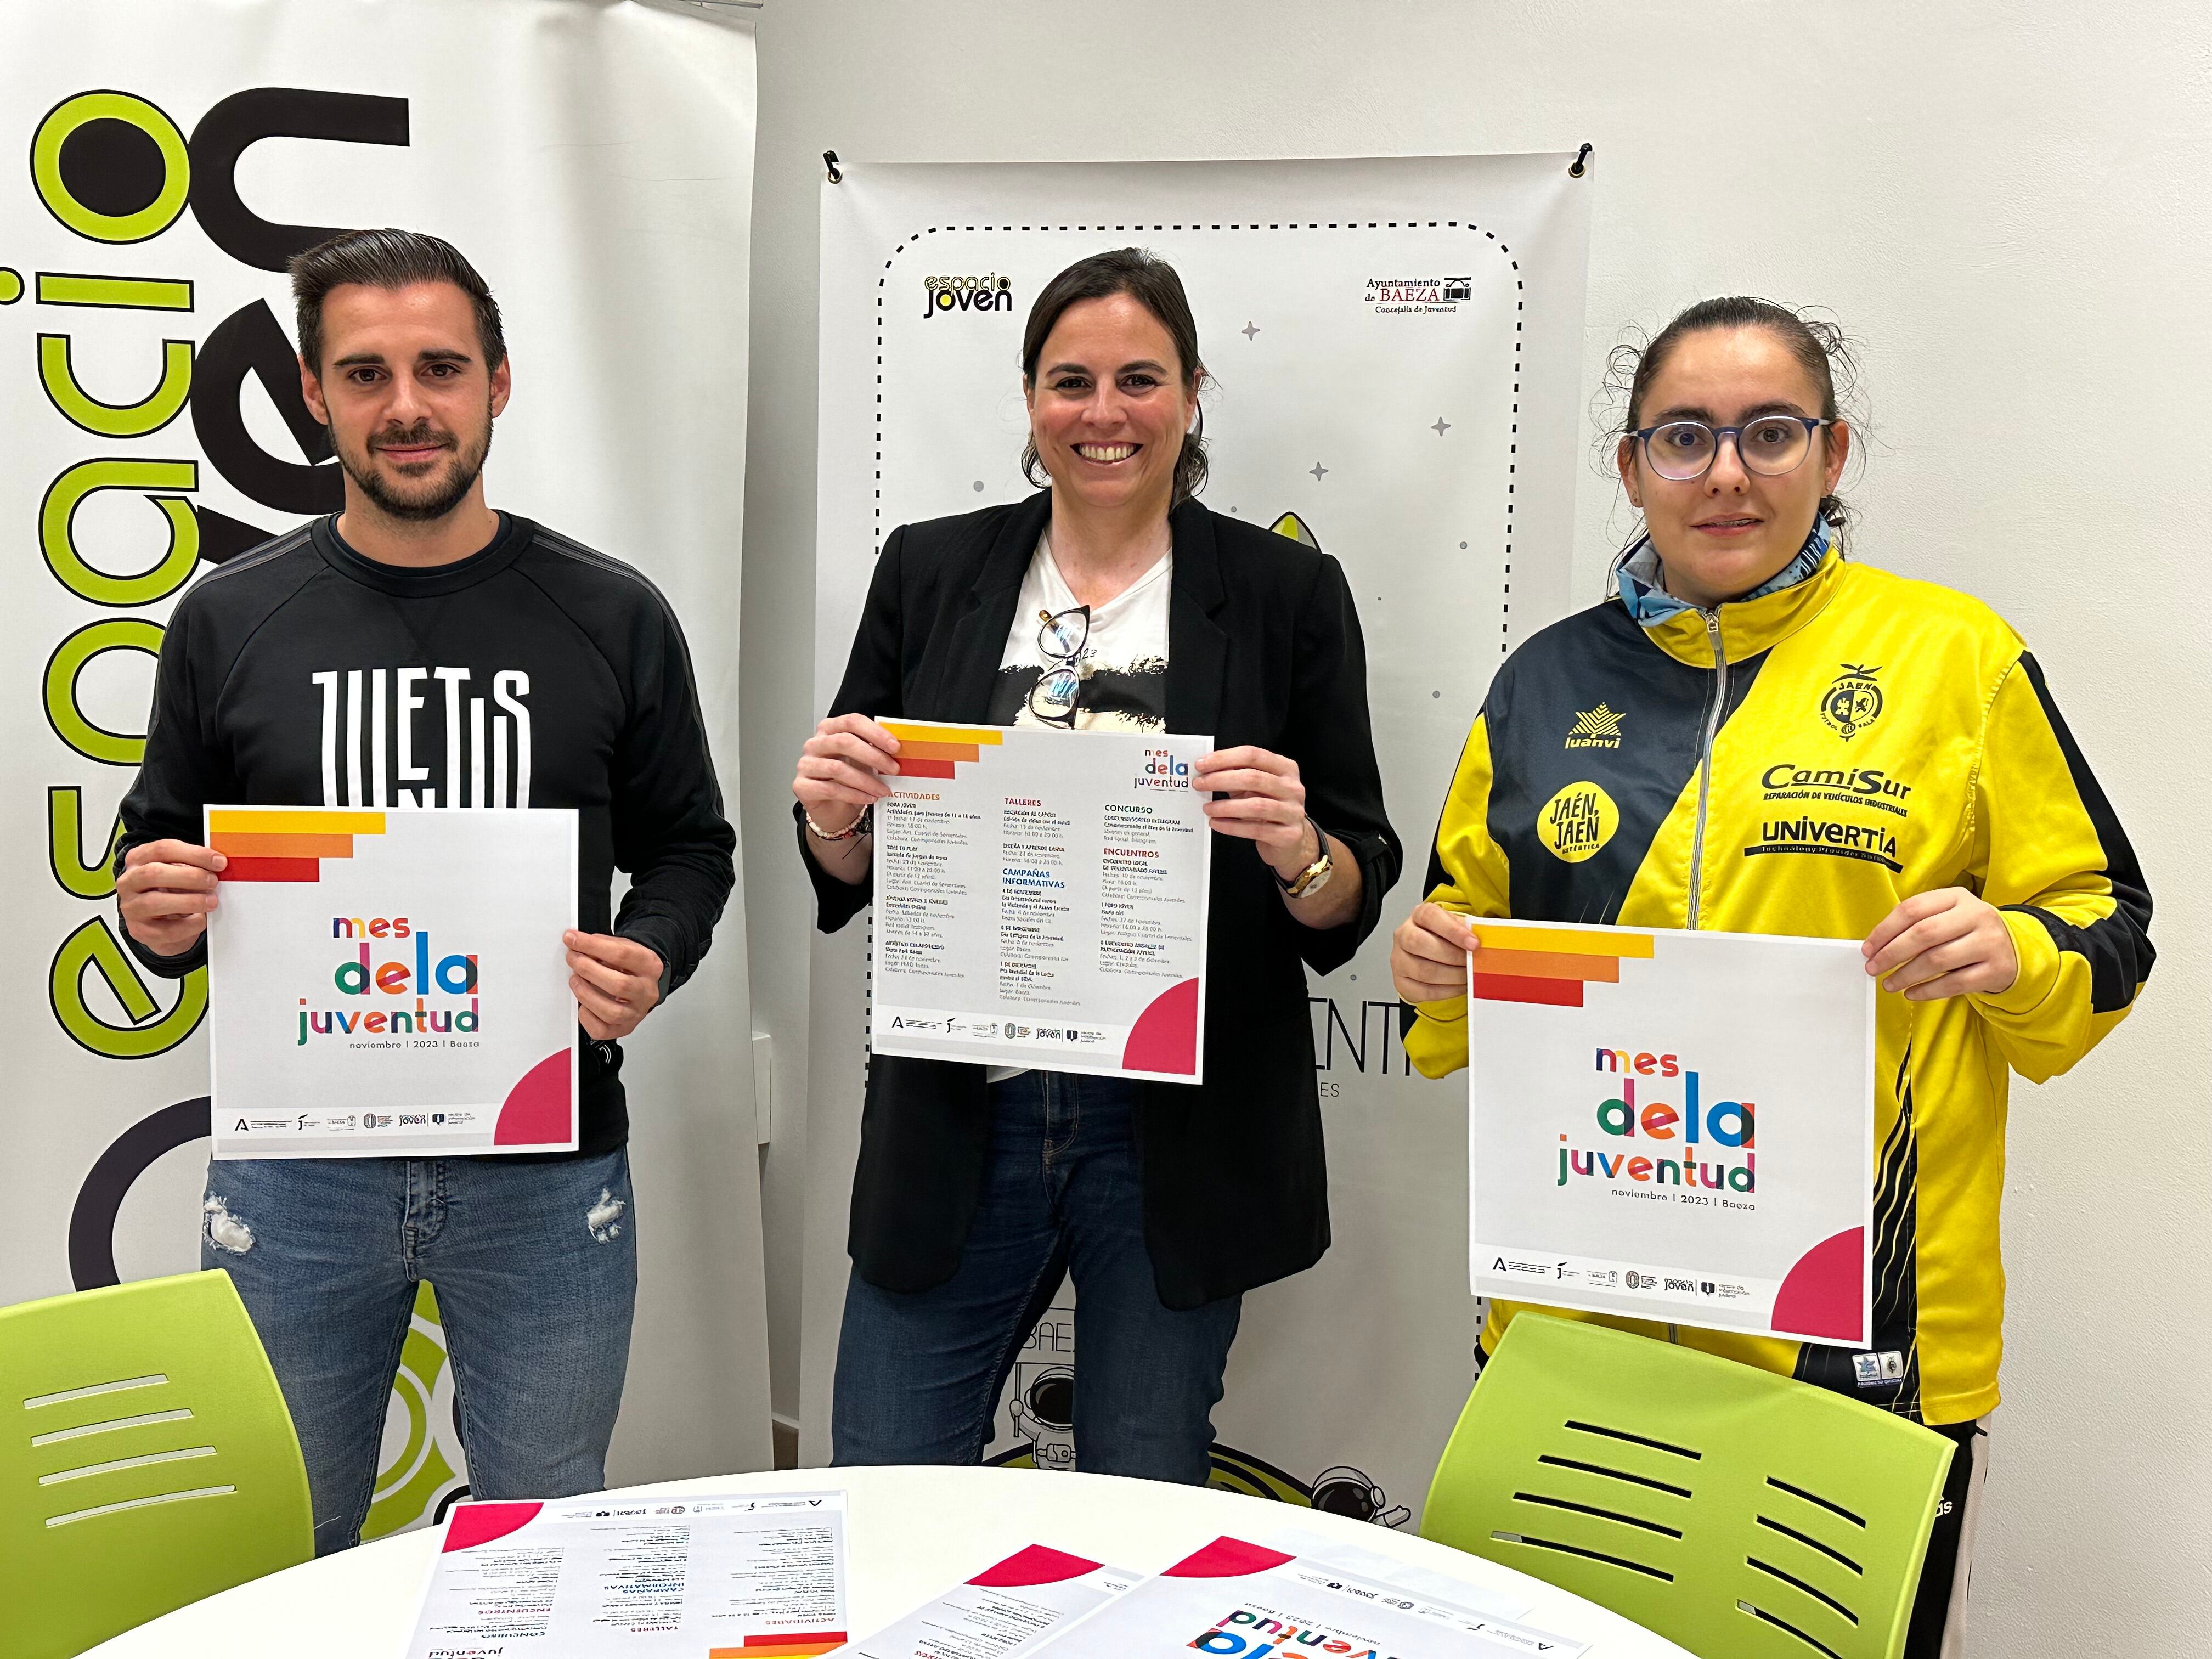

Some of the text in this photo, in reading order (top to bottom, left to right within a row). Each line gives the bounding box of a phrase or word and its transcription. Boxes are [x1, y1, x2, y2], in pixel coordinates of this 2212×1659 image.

[924, 272, 1011, 296] espacio
[1366, 278, 1441, 290] Ayuntamiento
[1365, 288, 1441, 302] de BAEZA
[923, 289, 1012, 319] joven
[1565, 736, 1621, 749] luanvi
[1134, 774, 1188, 788] juventud
[1762, 764, 1911, 799] CamiSur
[1005, 797, 1042, 806] TALLERES
[1812, 792, 1822, 800] DE
[1104, 804, 1153, 814] CONCURSO
[1103, 848, 1160, 858] ENCUENTROS
[1002, 867, 1051, 878] CAMPAÑAS
[1002, 877, 1065, 888] INFORMATIVAS
[332, 917, 410, 939] mes
[297, 997, 479, 1046] juventud
[349, 1040, 402, 1048] noviembre
[1596, 1048, 1679, 1077] mes
[1558, 1133, 1755, 1193] juventud
[1612, 1189, 1756, 1211] noviembre 2023 Baeza
